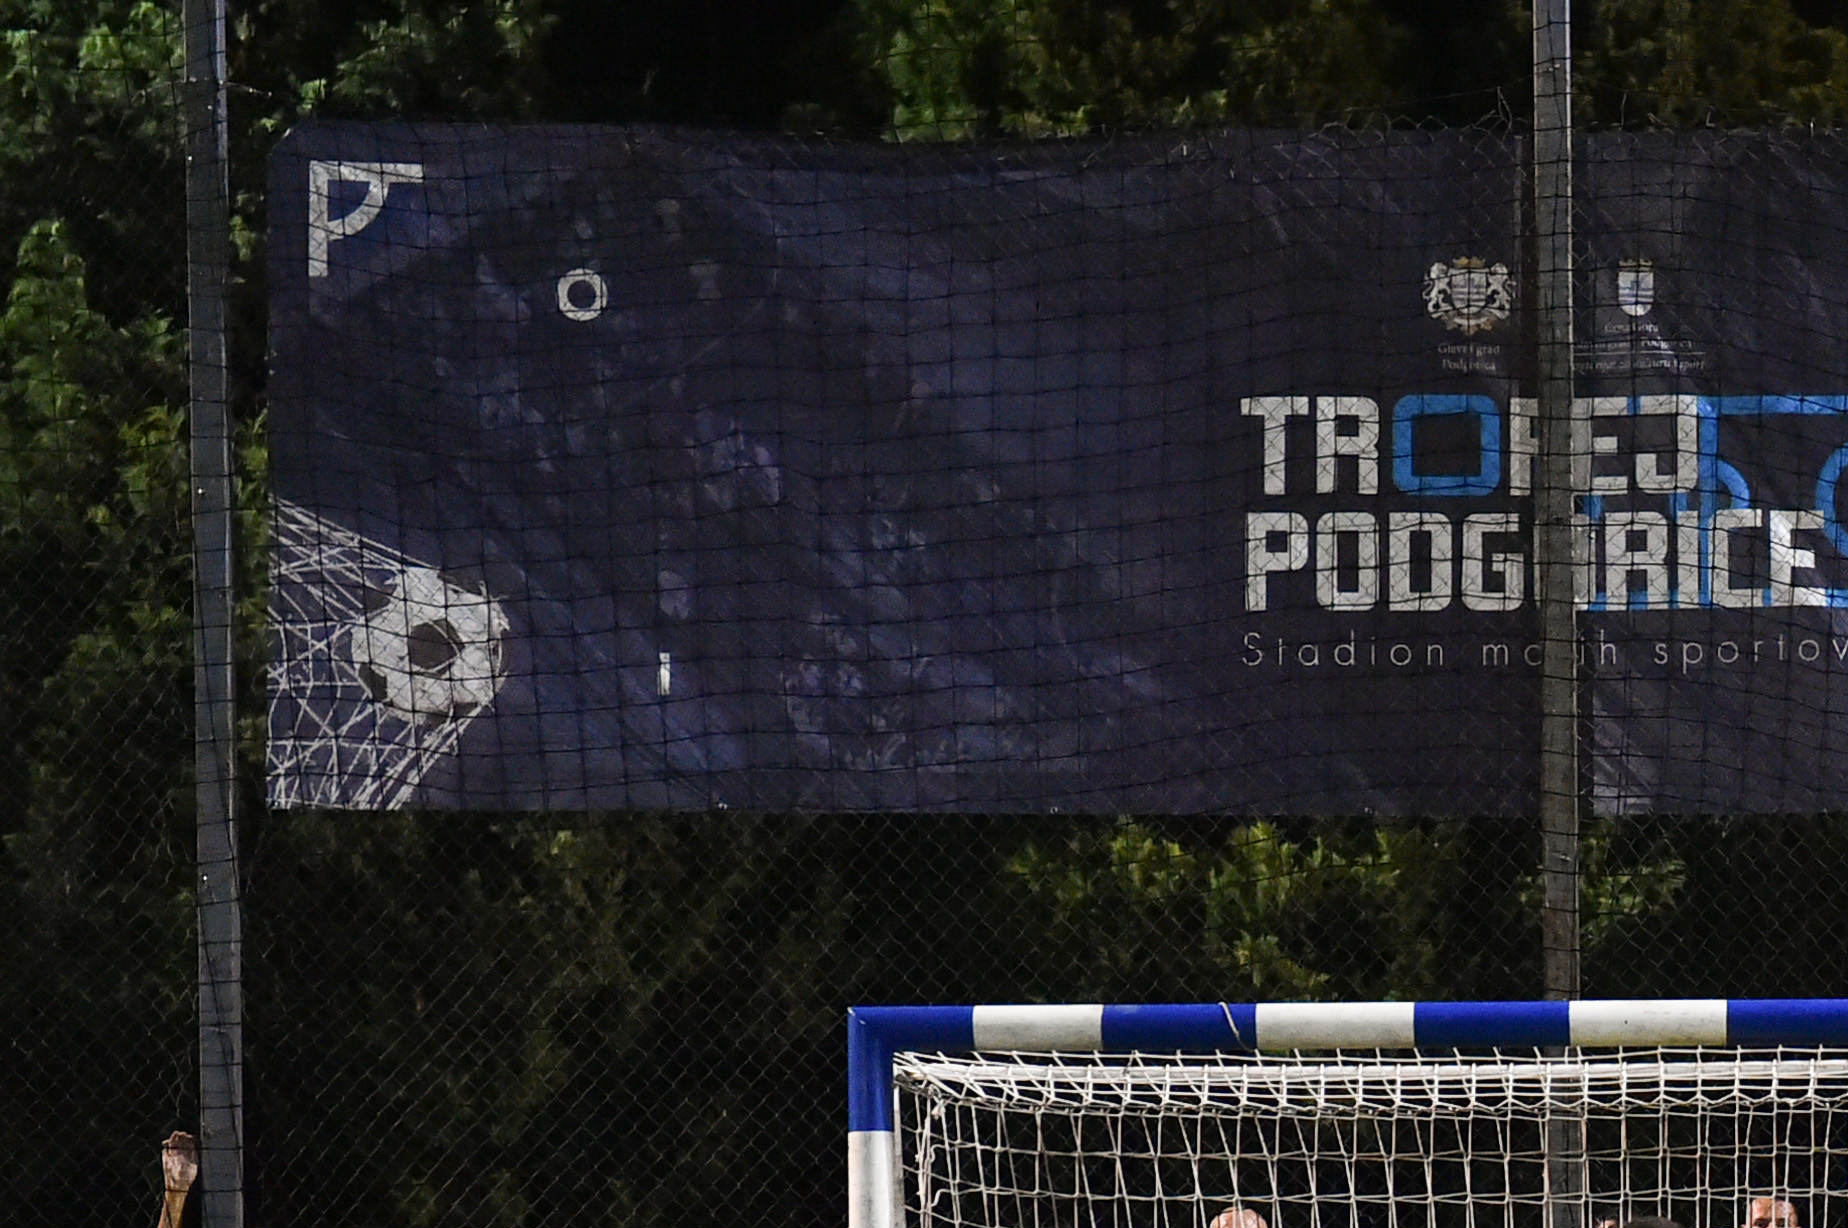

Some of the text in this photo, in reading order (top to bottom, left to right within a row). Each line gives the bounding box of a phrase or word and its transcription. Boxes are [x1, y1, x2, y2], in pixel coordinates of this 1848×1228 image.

[1240, 395, 1699, 496] TROFEJ
[1241, 631, 1445, 667] Stadion
[1482, 628, 1617, 666] maih
